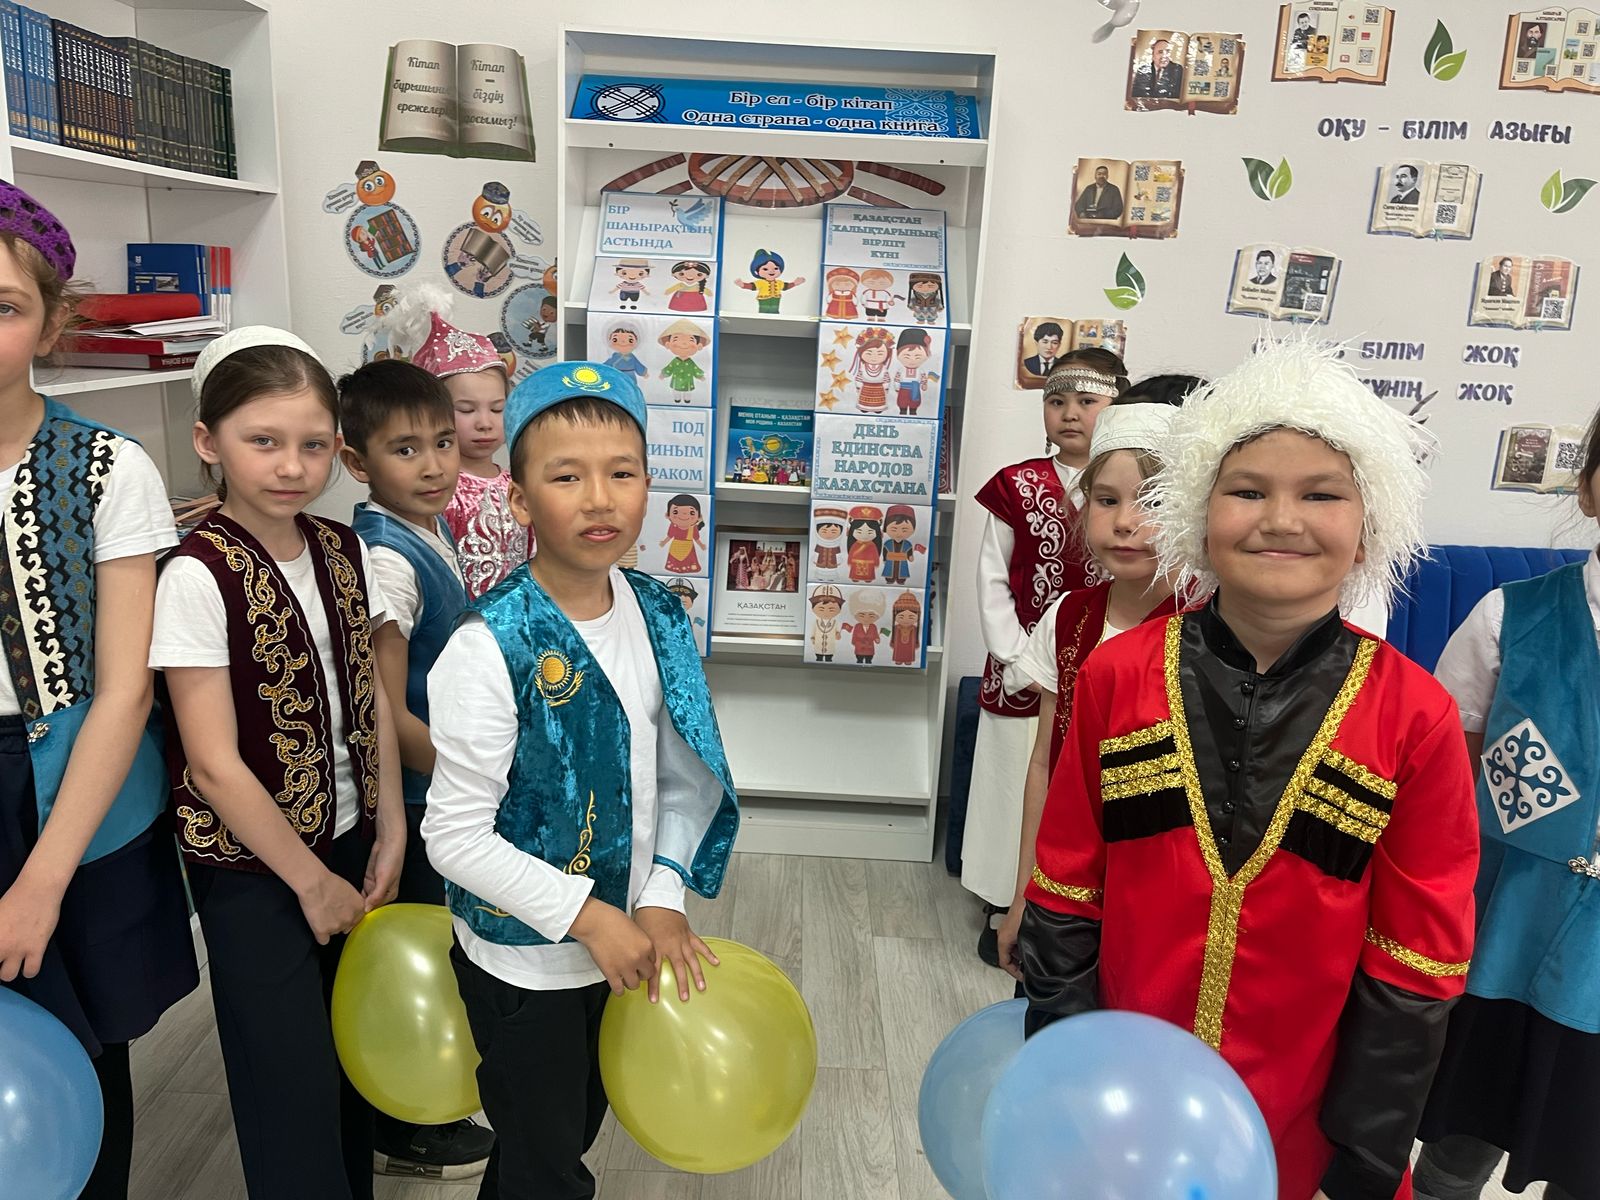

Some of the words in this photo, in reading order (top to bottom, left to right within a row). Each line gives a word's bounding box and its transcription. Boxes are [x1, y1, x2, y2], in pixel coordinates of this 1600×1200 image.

[407, 56, 440, 70] Кітап
[471, 59, 505, 73] Кітап
[473, 88, 504, 104] біздің
[730, 91, 761, 107] Бір
[766, 96, 790, 105] ел
[806, 94, 837, 110] бір
[842, 96, 894, 111] кітап
[682, 109, 736, 125] Одна
[739, 113, 810, 128] страна
[825, 116, 876, 131] одна
[881, 119, 940, 133] книга
[1317, 118, 1366, 141] ОҚУ
[1402, 120, 1468, 140] БІЛІМ
[1490, 120, 1572, 144] АЗЫҒЫ
[608, 205, 630, 214] БІР
[853, 213, 922, 225] ҚАЗАҚСТАН
[606, 221, 713, 235] ШАНЫРАҚТЫҢ
[832, 224, 941, 239] ХАЛЫҚТАРЫНЫҢ
[604, 236, 673, 249] АСТЫНДА
[870, 250, 900, 259] КҮНІ
[1361, 341, 1425, 361] БІЛІМ
[1464, 344, 1520, 368] ЖОҚ
[1458, 383, 1514, 405] ЖОҚ
[672, 422, 704, 436] ПОД
[853, 424, 899, 439] ДЕНЬ
[832, 441, 922, 458] ЕДИНСТВА
[834, 460, 913, 477] НАРОДОВ
[819, 477, 927, 495] КАЗАХСТАНА
[737, 602, 786, 611] ҚАЗАҚСТАН
